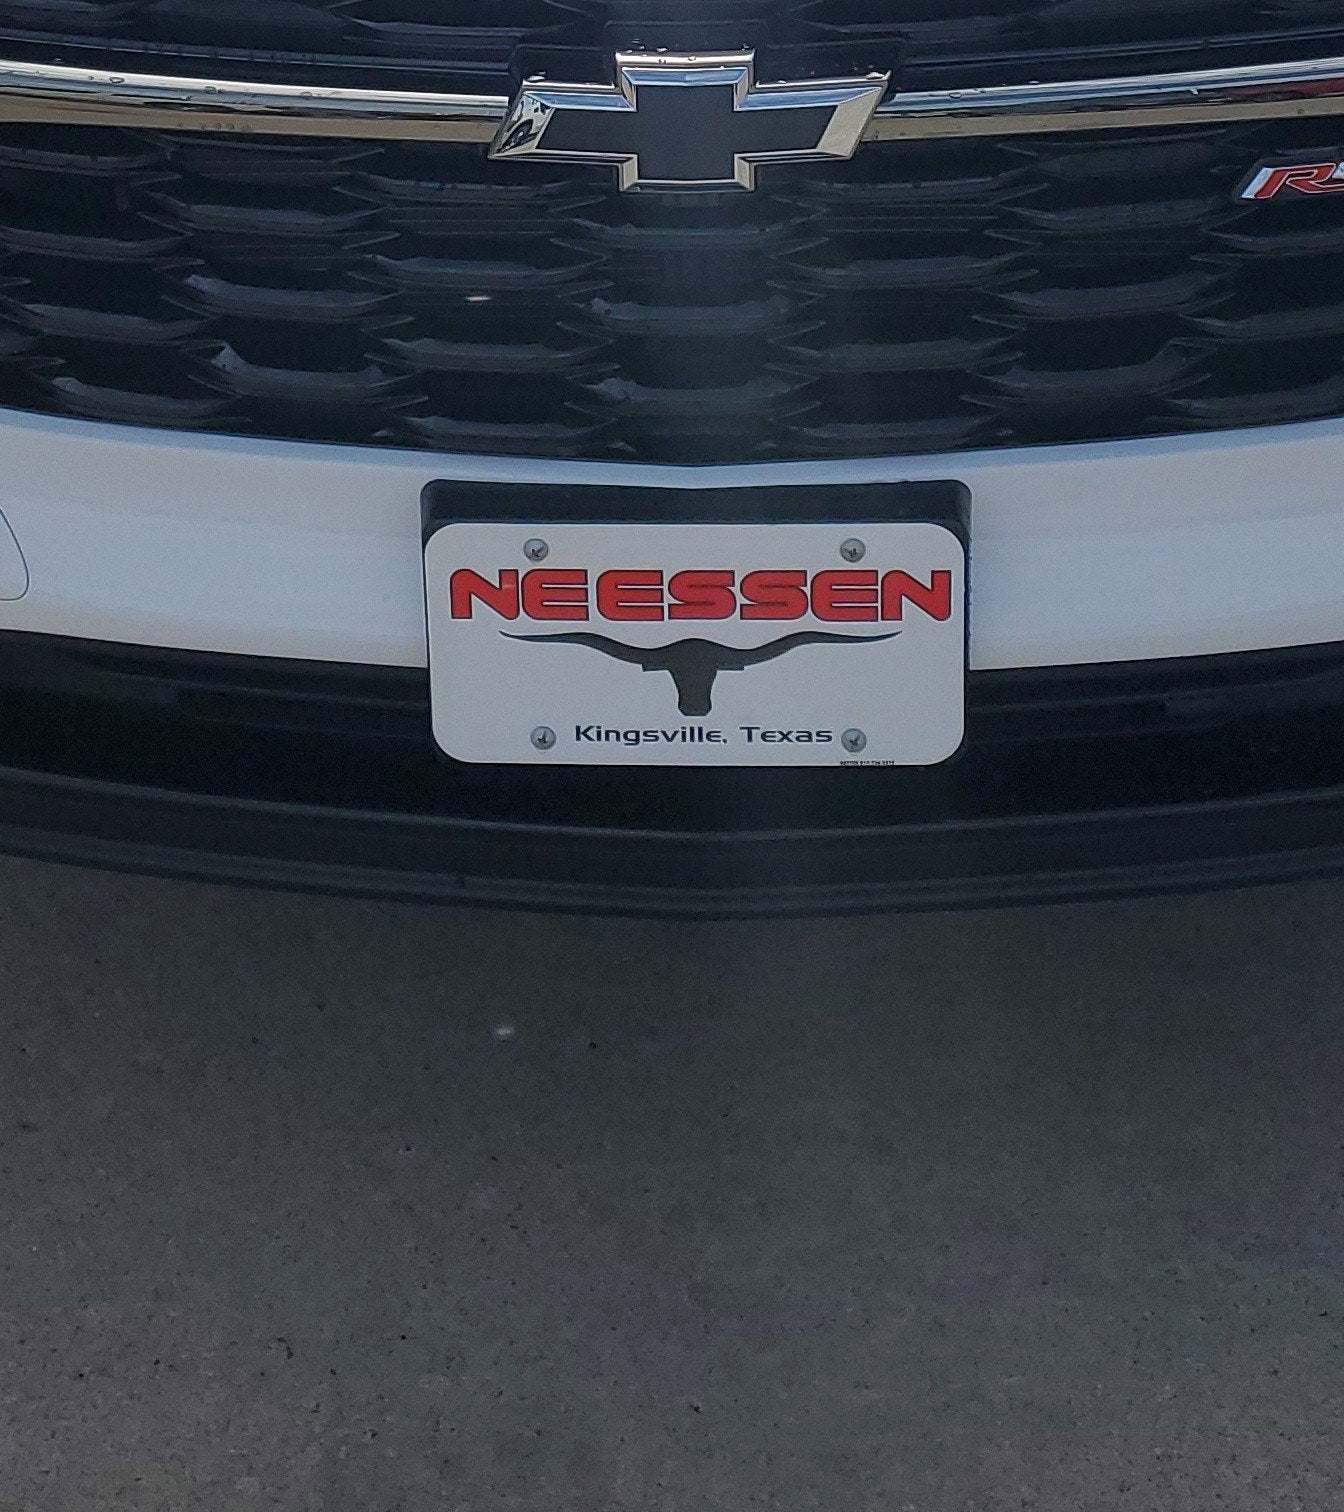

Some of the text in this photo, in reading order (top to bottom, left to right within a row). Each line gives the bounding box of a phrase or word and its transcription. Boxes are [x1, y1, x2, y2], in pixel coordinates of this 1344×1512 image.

[450, 569, 952, 622] NEESSEN
[574, 725, 833, 746] Kingsville, Texas
